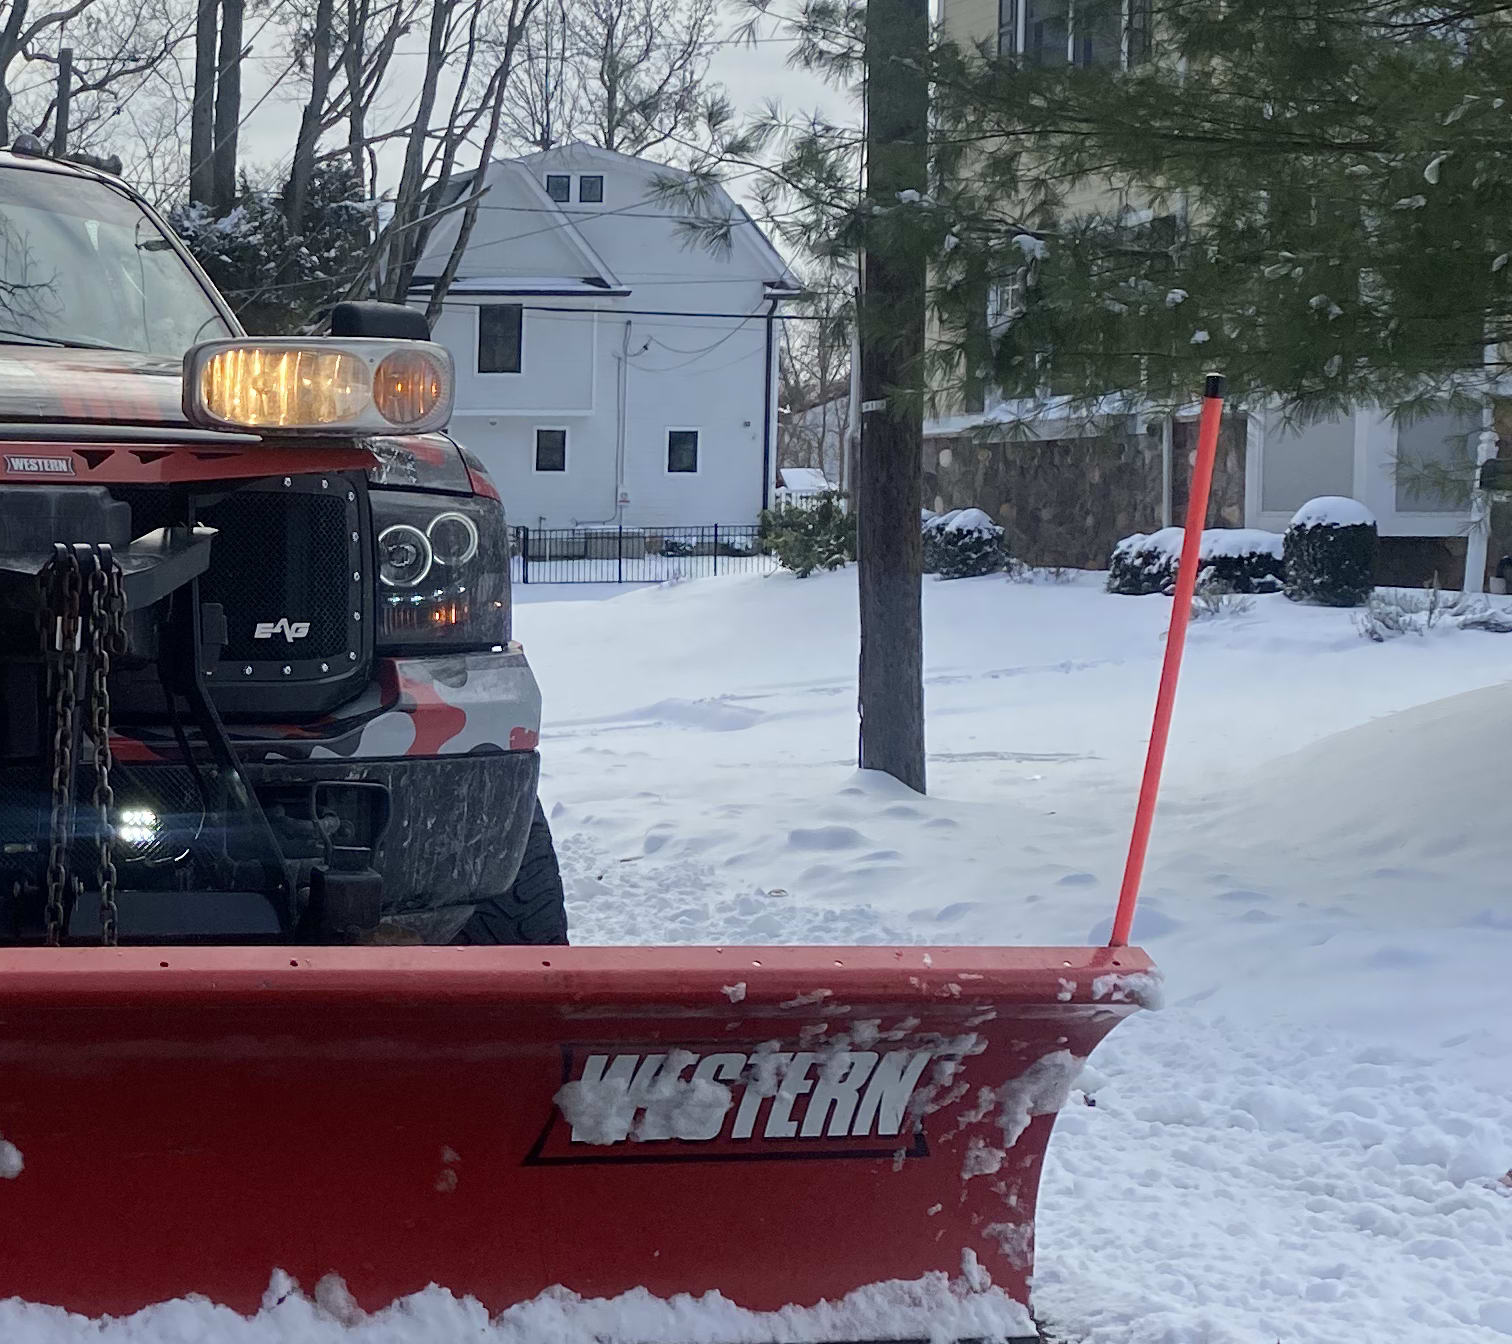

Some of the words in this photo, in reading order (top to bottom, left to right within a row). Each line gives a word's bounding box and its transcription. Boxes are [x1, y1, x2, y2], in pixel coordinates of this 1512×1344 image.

[10, 457, 68, 472] WESTERN
[254, 617, 311, 643] EAG
[571, 1052, 931, 1141] WSTERN
